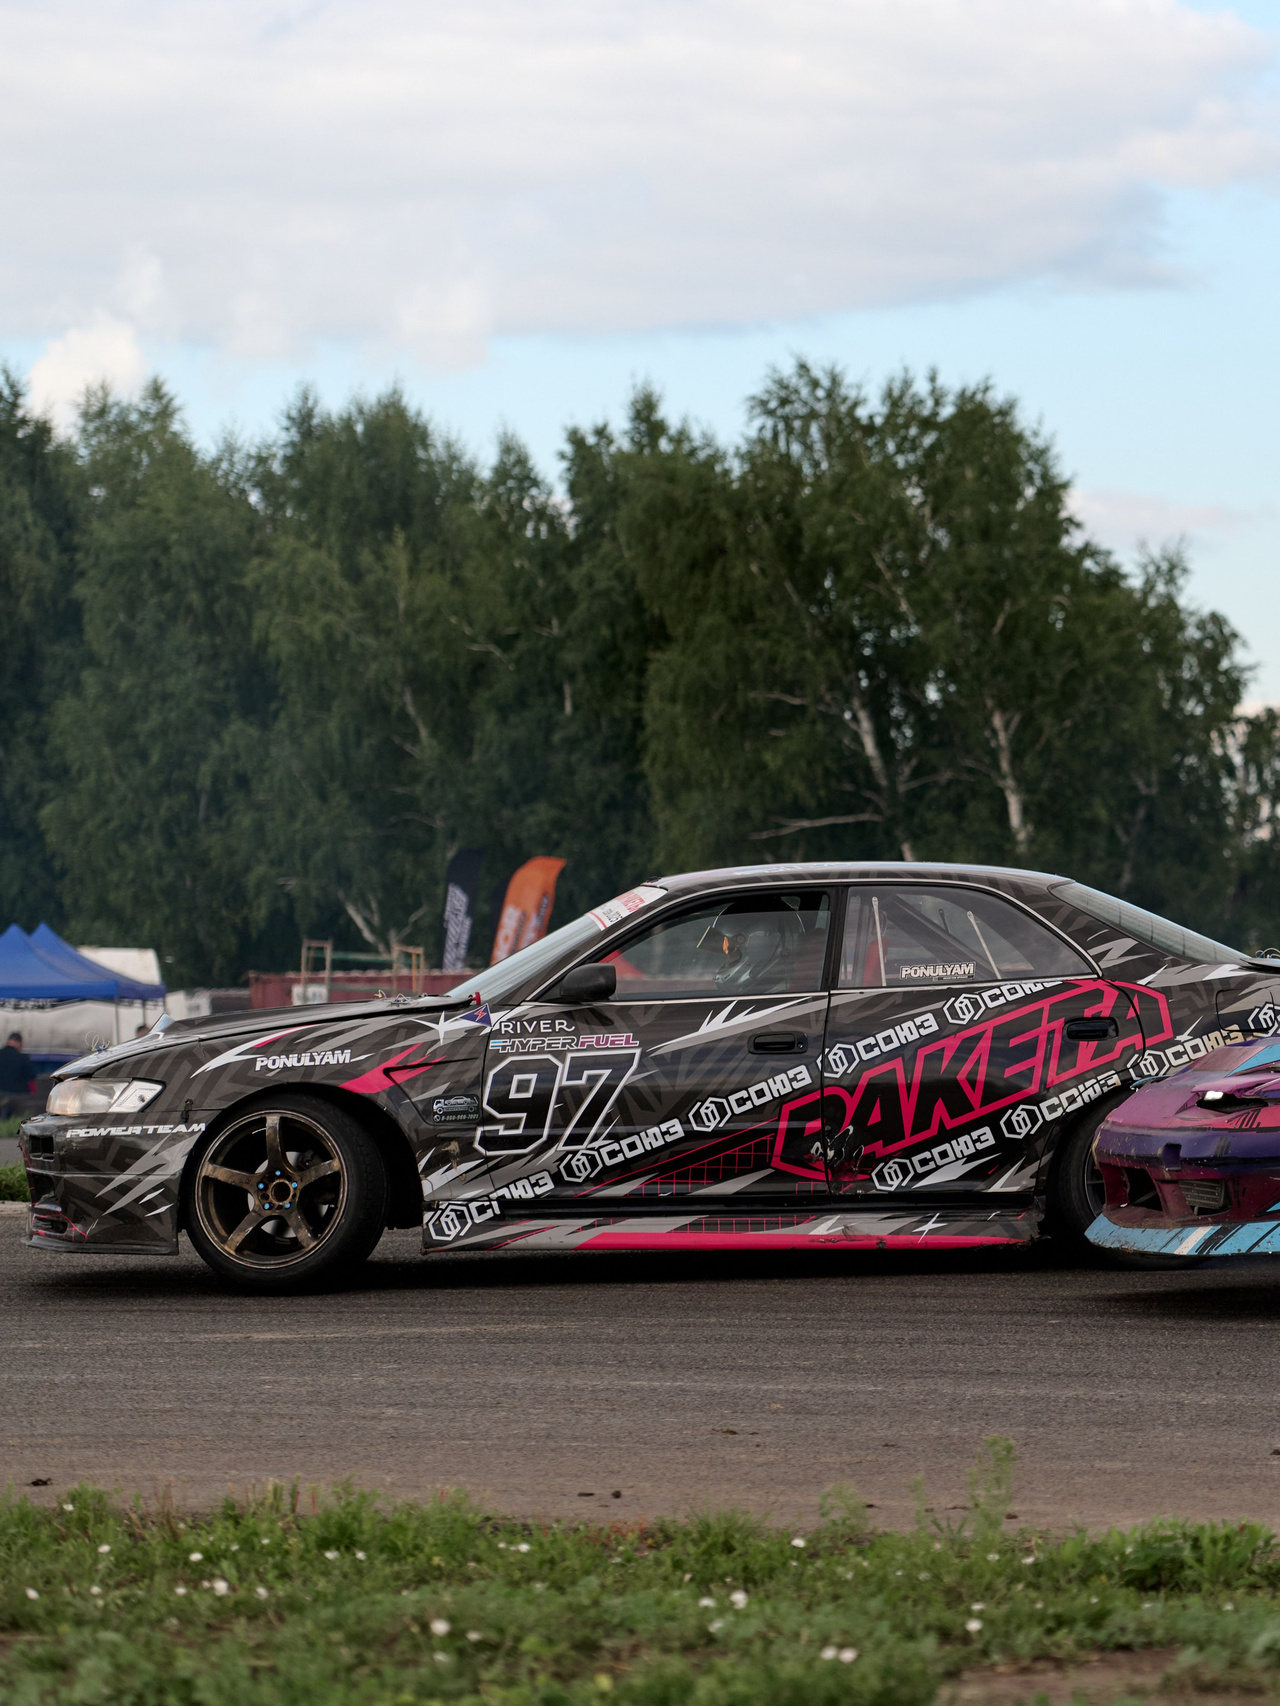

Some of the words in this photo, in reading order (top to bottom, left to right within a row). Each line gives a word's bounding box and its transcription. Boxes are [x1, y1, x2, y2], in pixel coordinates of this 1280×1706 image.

[901, 963, 974, 978] PONULYAM
[501, 1019, 576, 1034] RIVER
[255, 1050, 352, 1071] PONULYAM
[473, 1048, 641, 1156] 97
